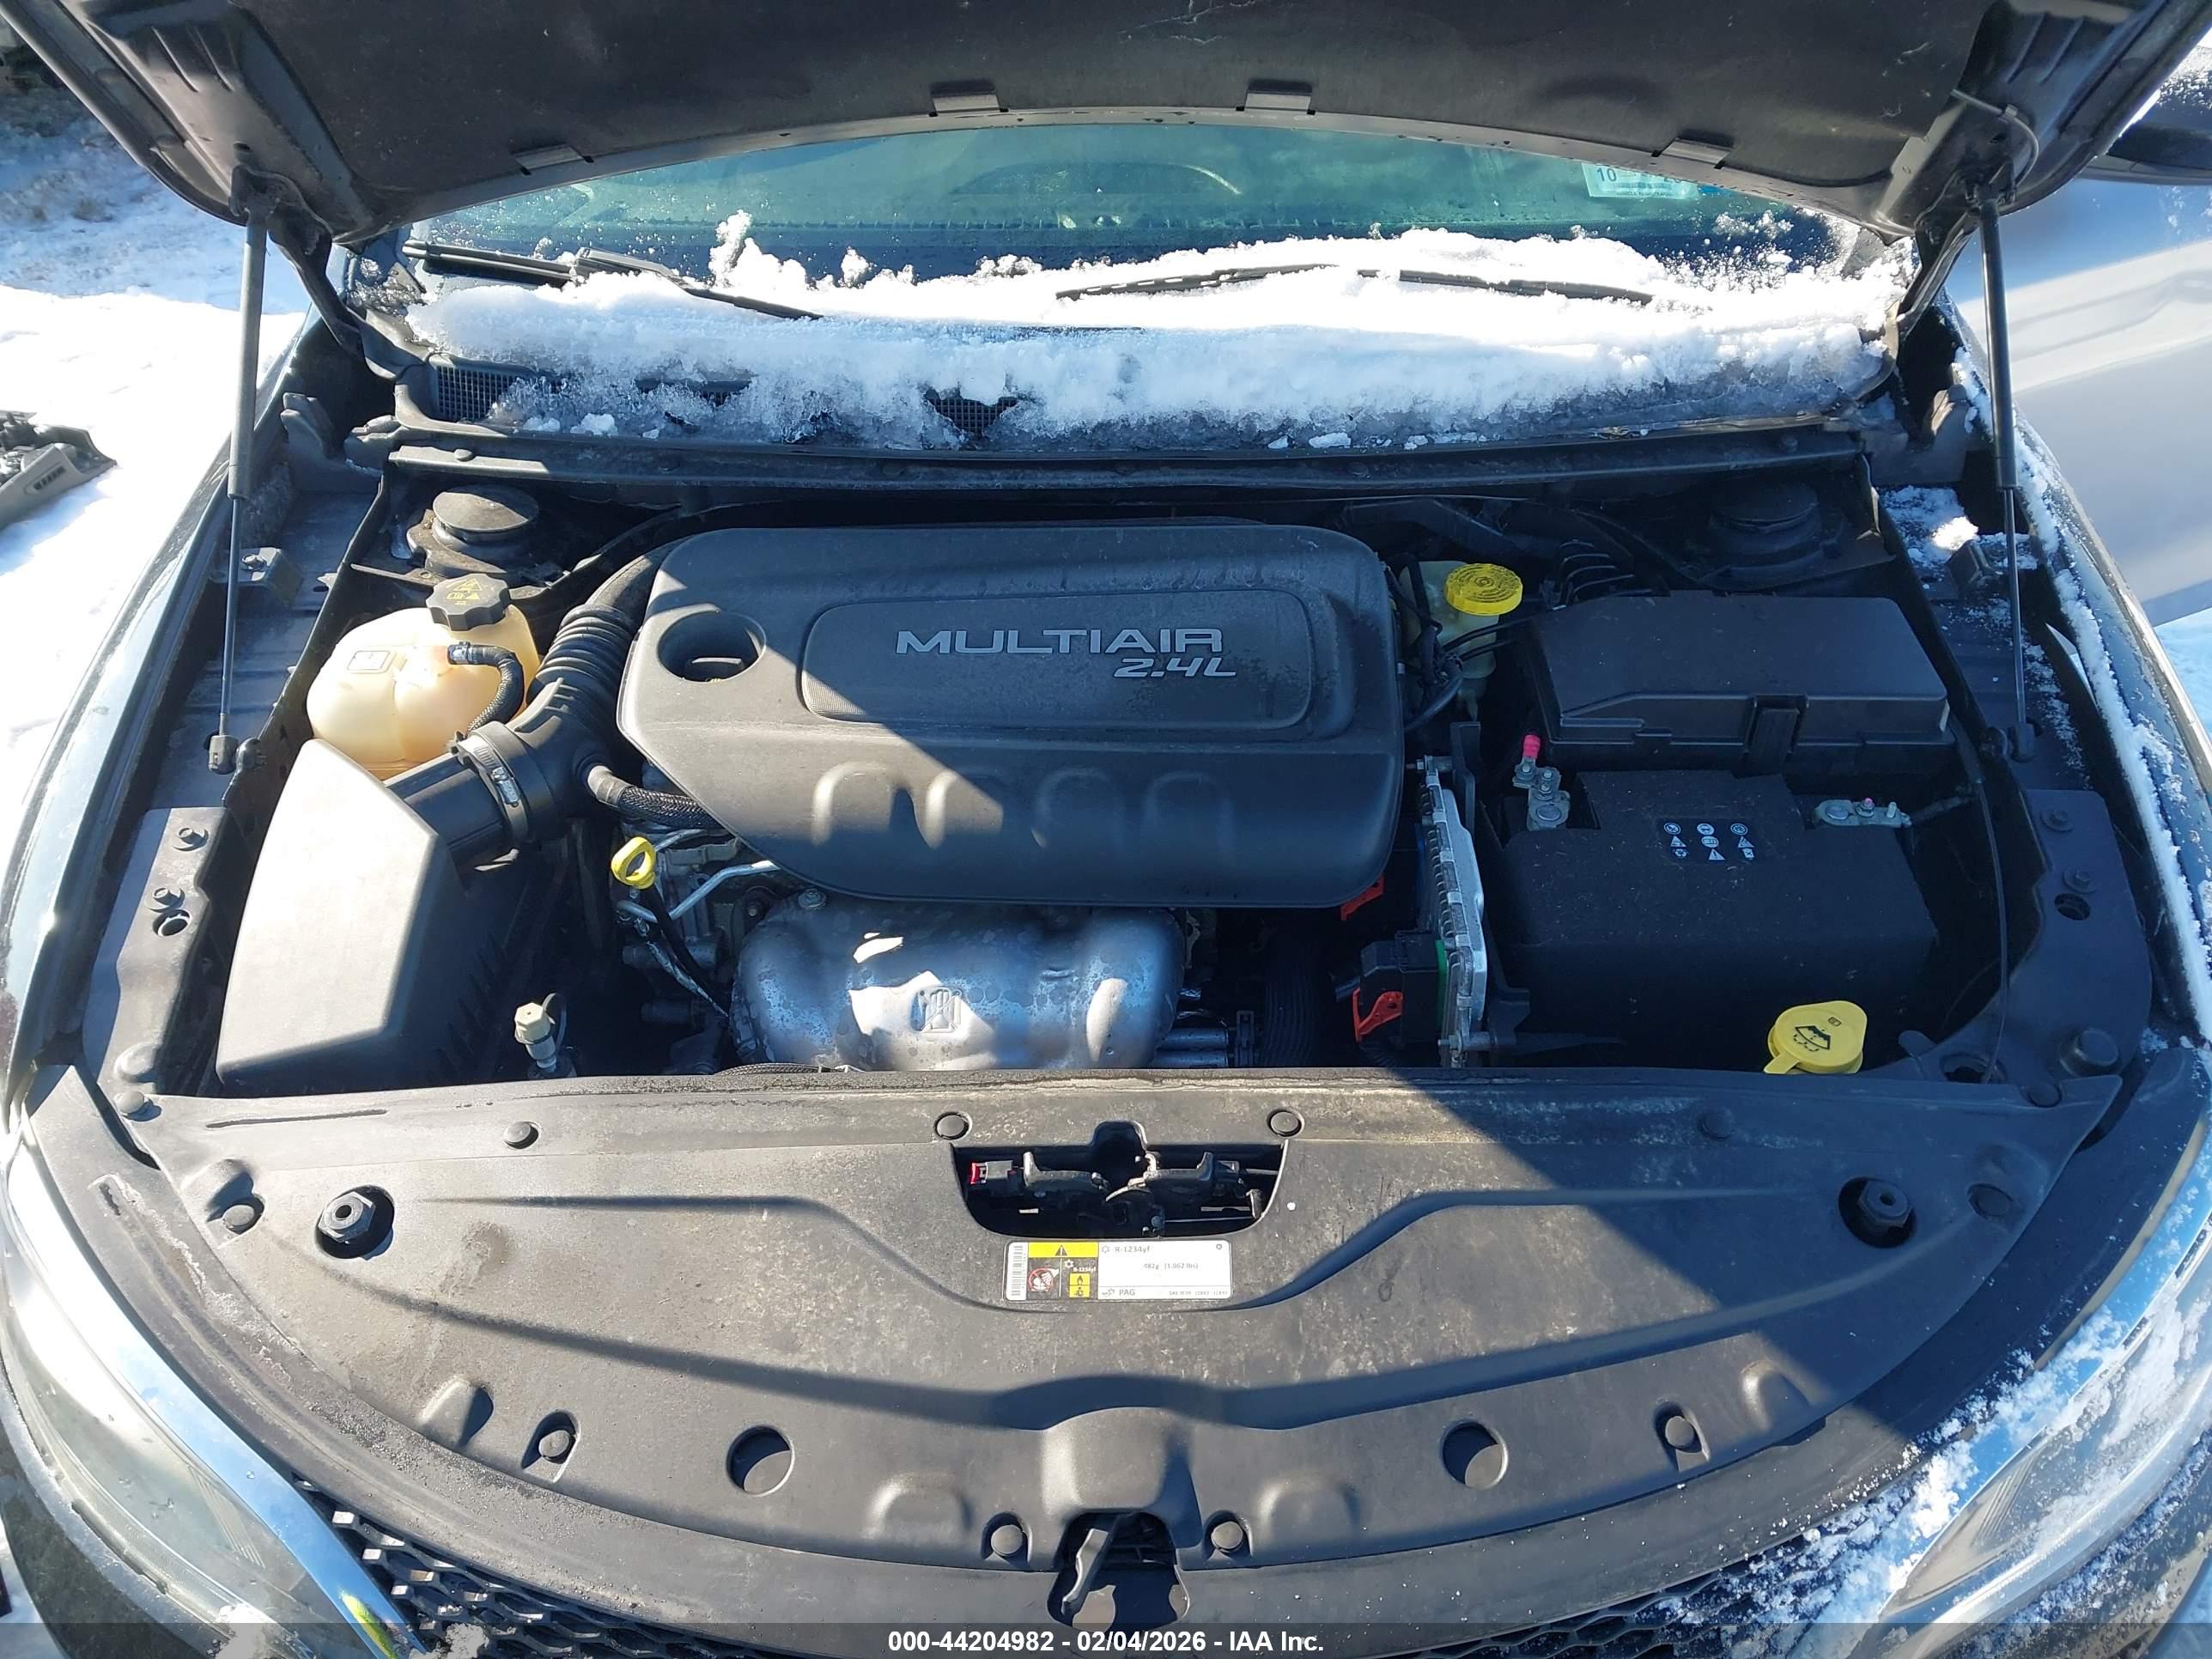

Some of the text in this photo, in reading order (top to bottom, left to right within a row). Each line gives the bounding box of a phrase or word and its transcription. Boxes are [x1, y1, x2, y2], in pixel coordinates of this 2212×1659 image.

[1596, 167, 1617, 183] 10
[895, 628, 1223, 654] MULTIAIR
[1114, 657, 1237, 678] 2.4L
[1115, 1245, 1151, 1255] R-1234yf
